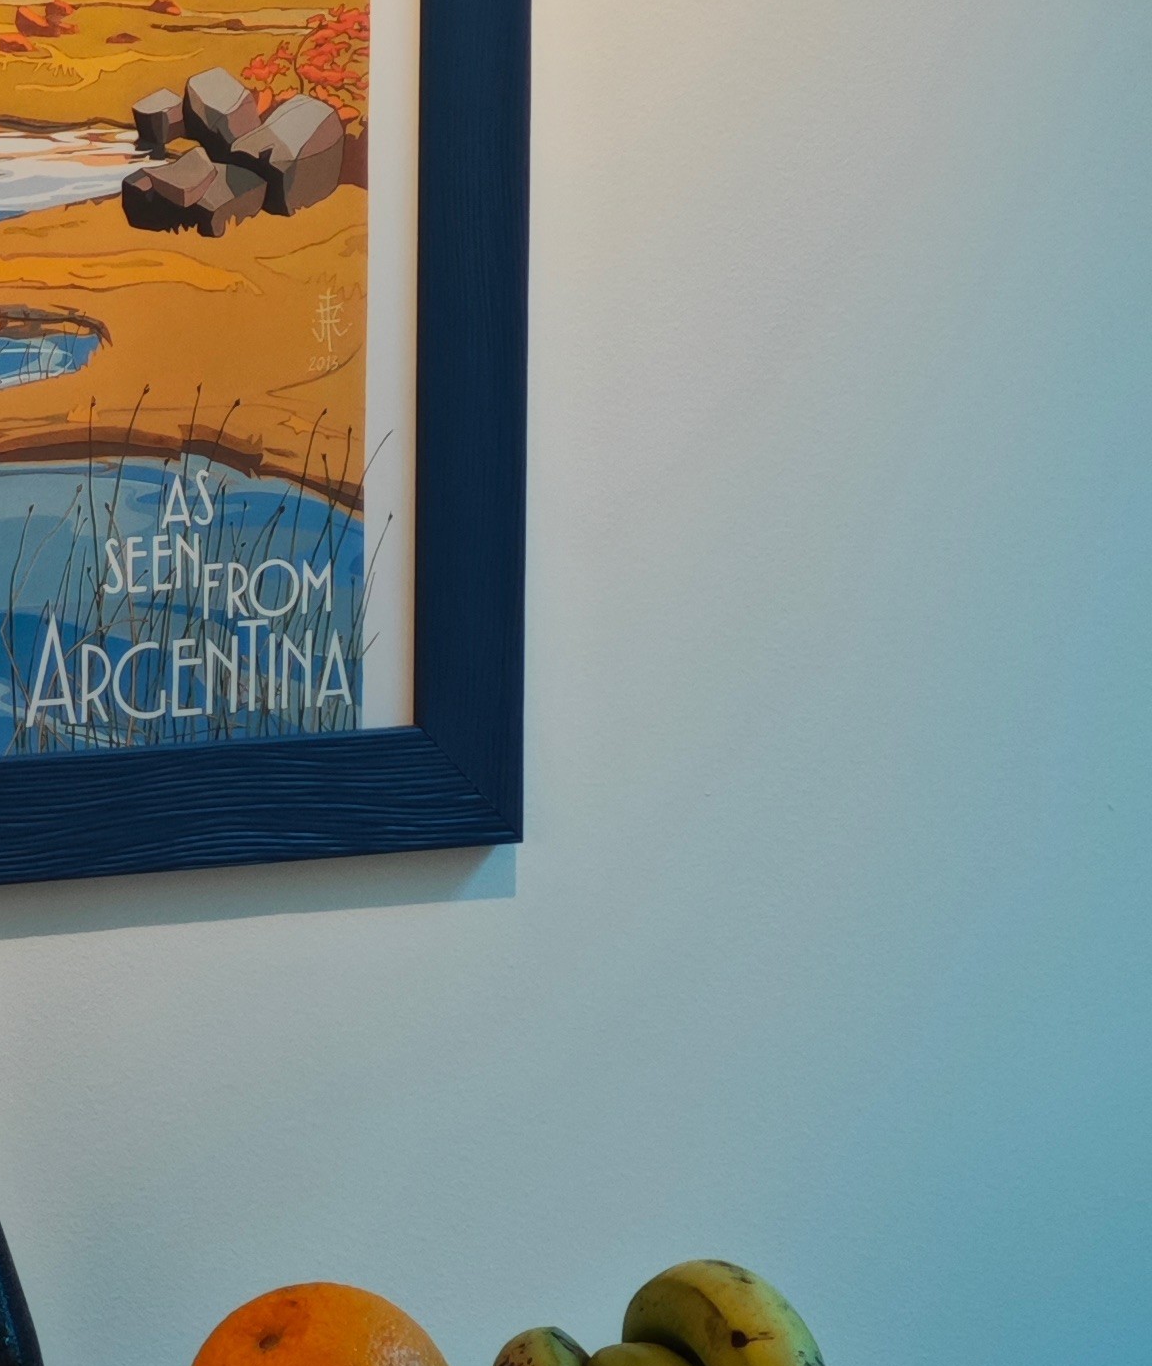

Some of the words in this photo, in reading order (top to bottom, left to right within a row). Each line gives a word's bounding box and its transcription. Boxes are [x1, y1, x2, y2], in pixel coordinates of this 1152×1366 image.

[161, 469, 215, 530] AS
[102, 532, 200, 595] SEEN
[203, 558, 333, 621] FROM
[25, 611, 353, 729] ARGENTINA
